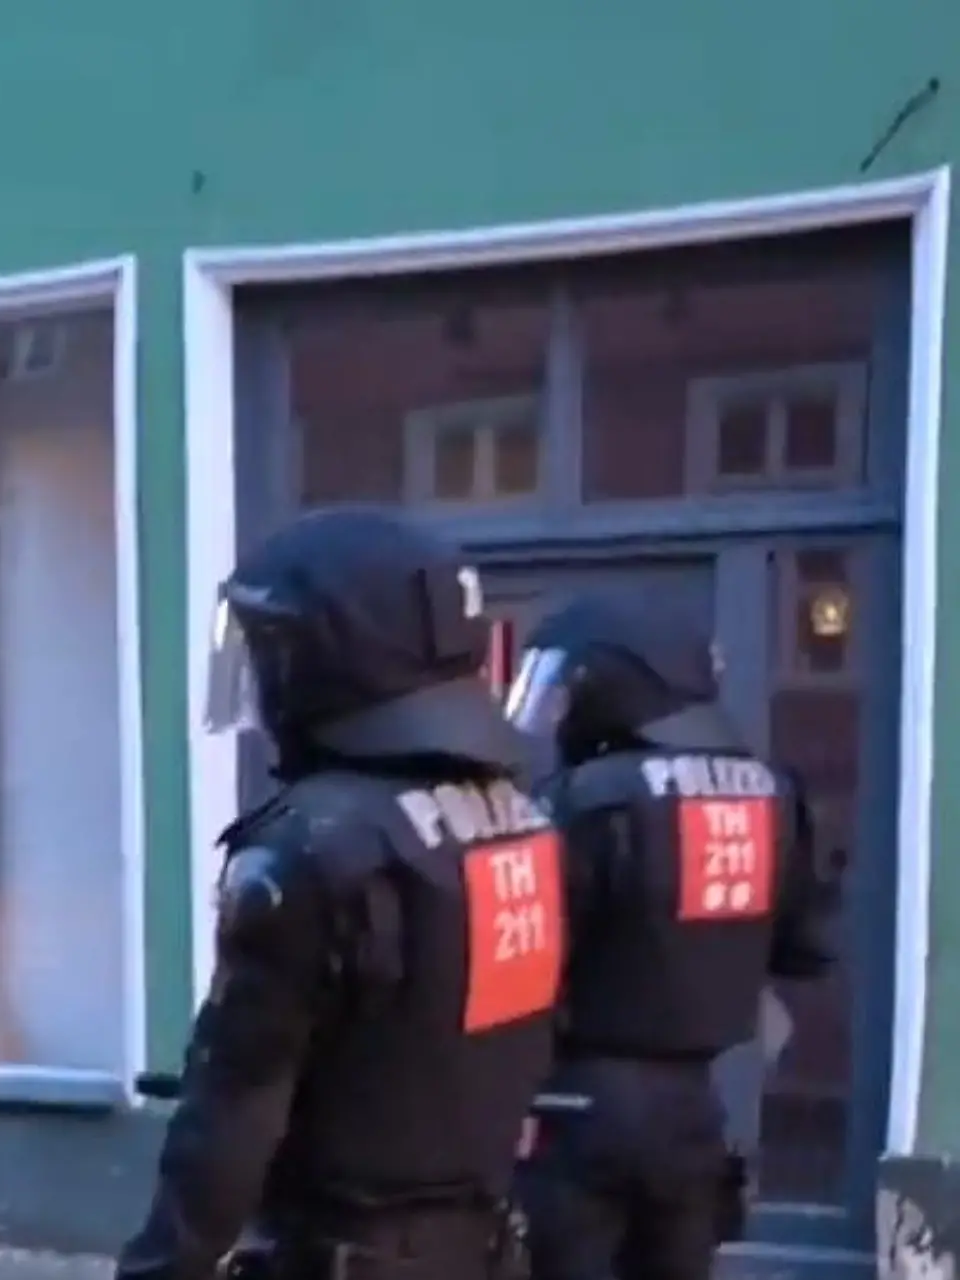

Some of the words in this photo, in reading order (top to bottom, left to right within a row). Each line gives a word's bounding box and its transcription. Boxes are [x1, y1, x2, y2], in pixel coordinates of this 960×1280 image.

[701, 802, 748, 837] TH
[489, 847, 537, 902] TH
[703, 837, 756, 878] 211
[492, 901, 547, 962] 211
